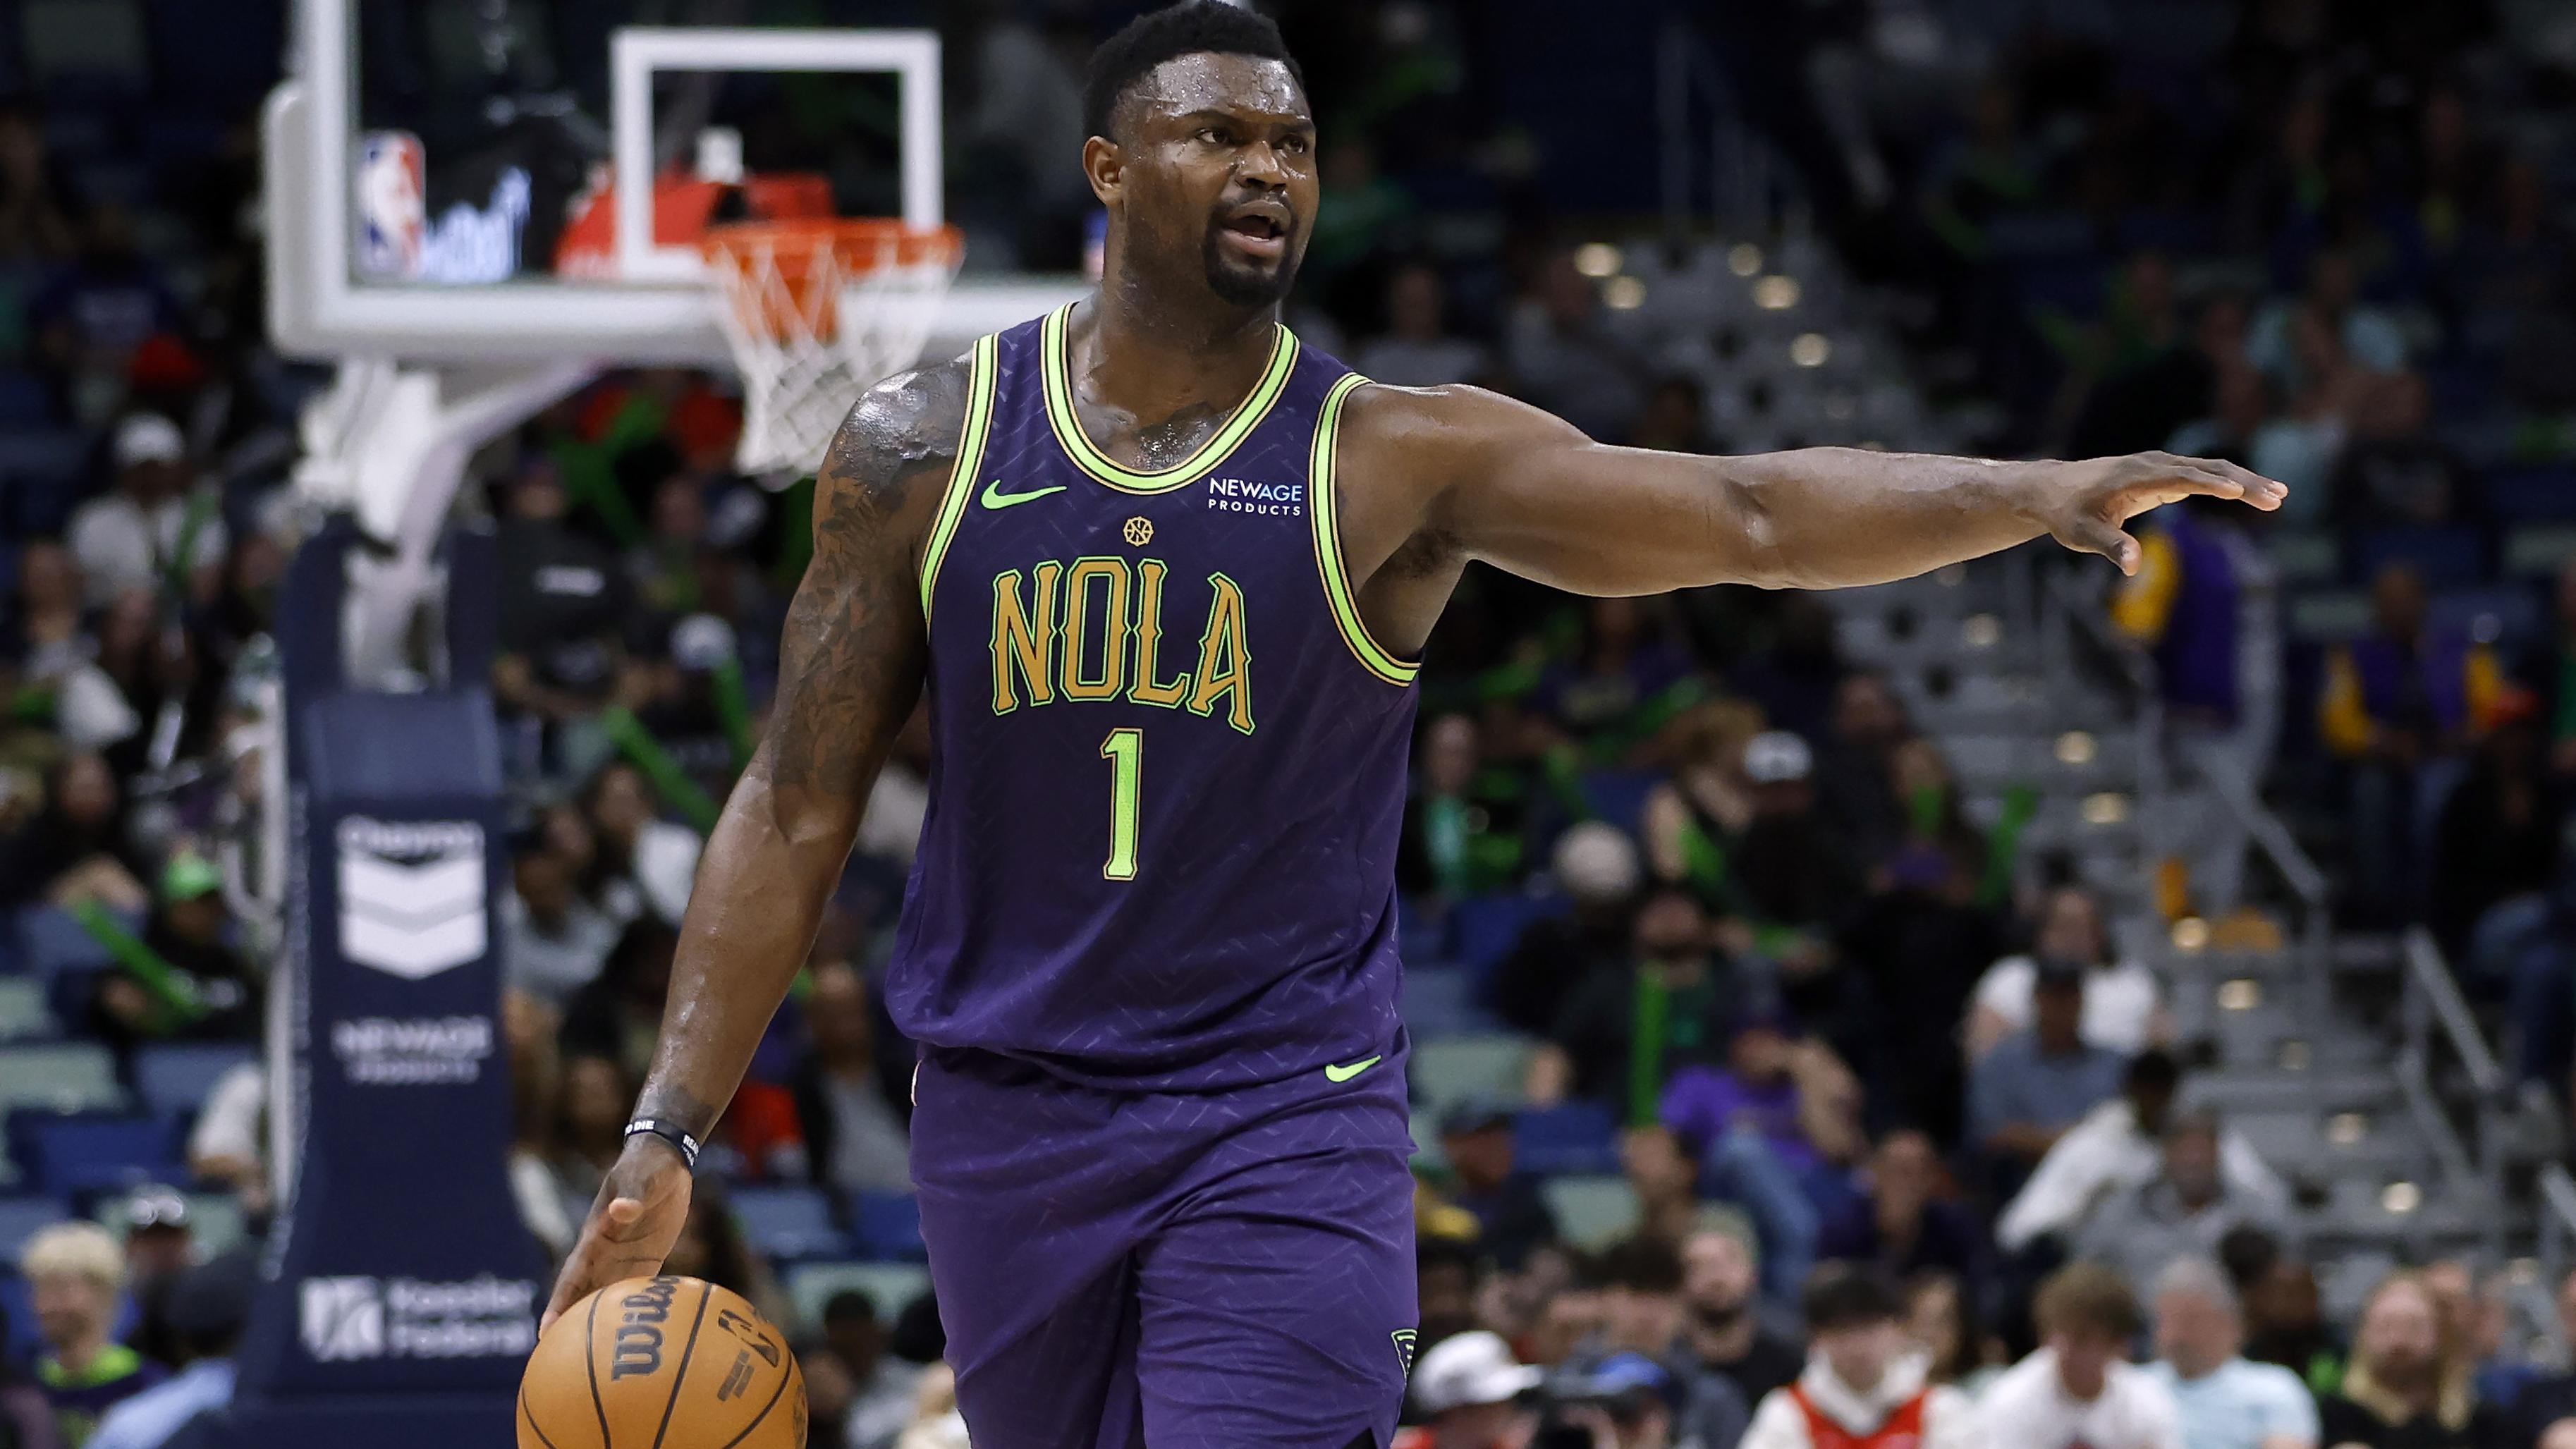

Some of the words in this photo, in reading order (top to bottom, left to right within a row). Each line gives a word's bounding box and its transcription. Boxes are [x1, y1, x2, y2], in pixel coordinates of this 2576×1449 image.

[1209, 477, 1303, 501] NEWAGE
[1208, 499, 1301, 516] PRODUCTS
[989, 556, 1256, 736] NOLA
[1099, 727, 1143, 881] 1
[633, 1120, 655, 1132] DIE
